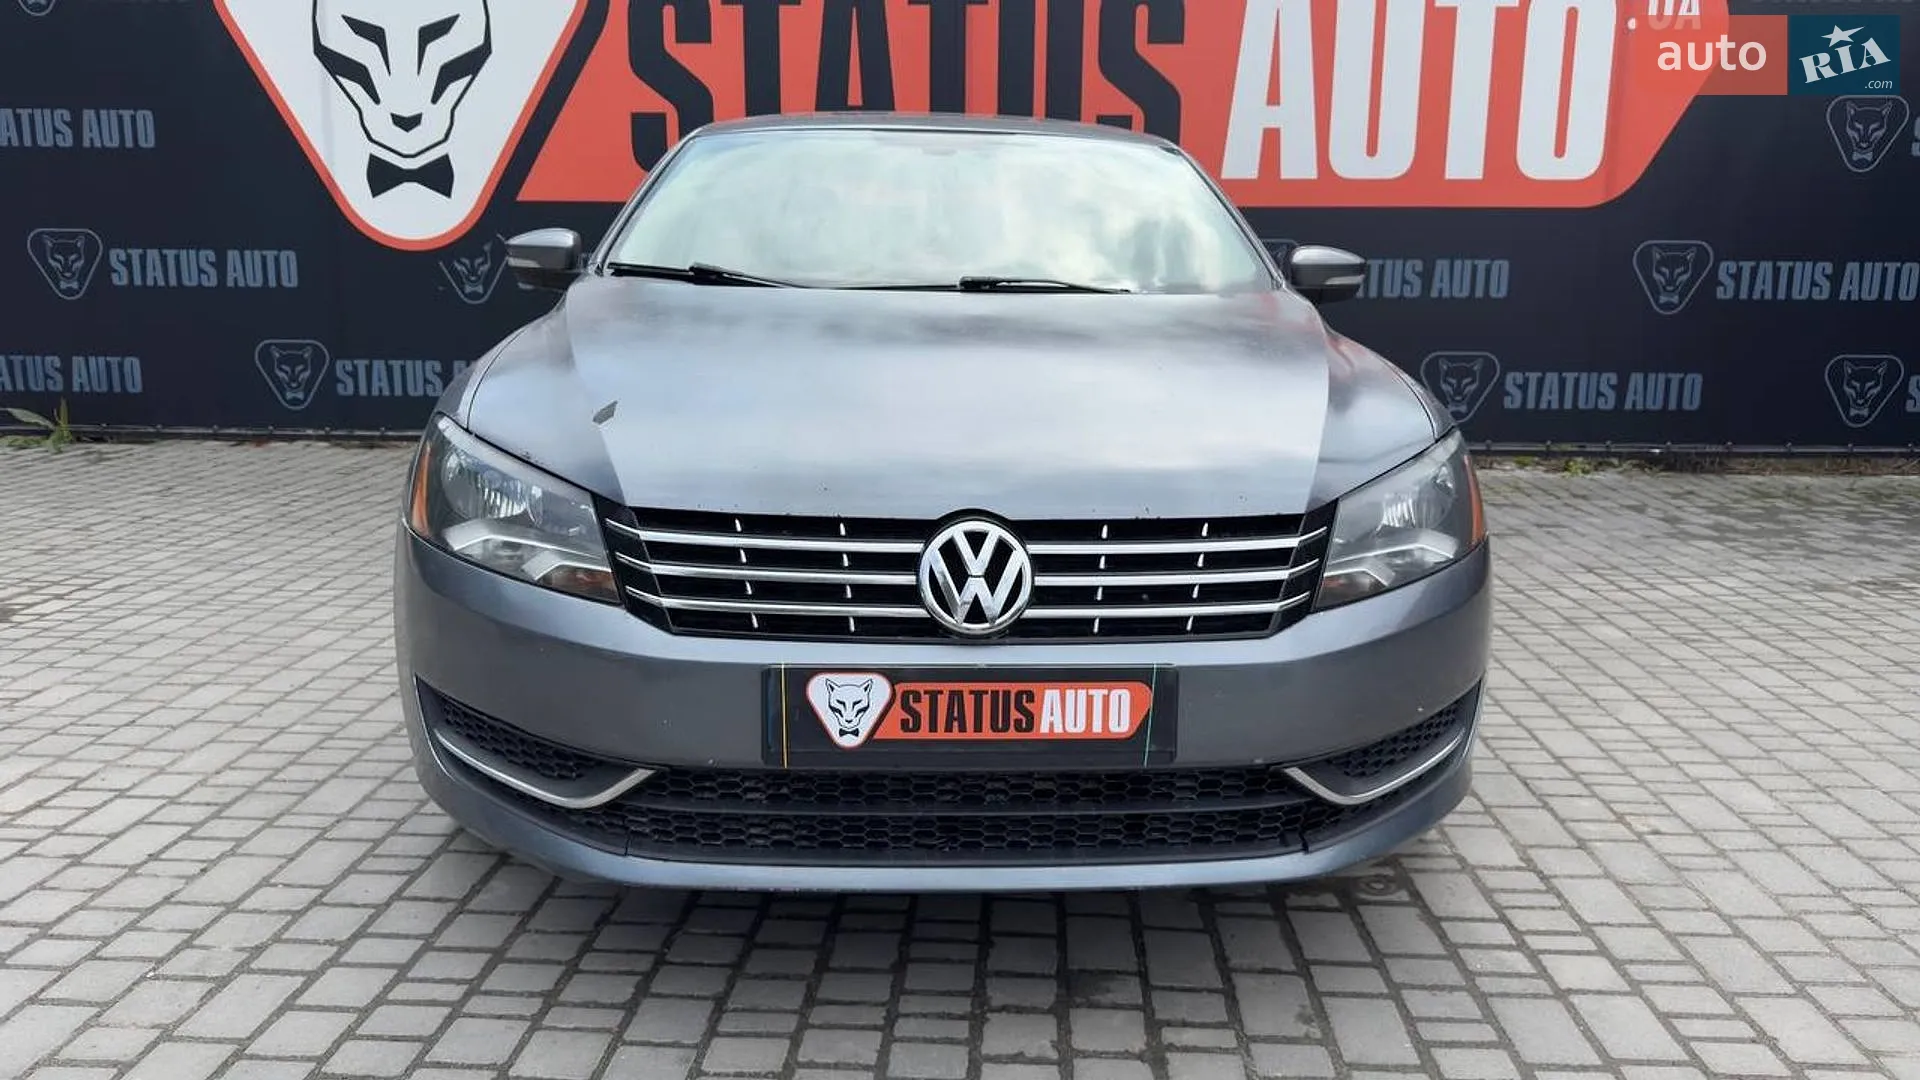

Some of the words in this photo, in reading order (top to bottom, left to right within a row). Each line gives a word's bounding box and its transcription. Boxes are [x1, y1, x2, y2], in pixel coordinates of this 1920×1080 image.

[628, 0, 1186, 173] STATUS
[1221, 0, 1618, 180] AUTO
[82, 109, 155, 148] AUTO
[109, 248, 218, 288] STATUS
[226, 250, 299, 288] AUTO
[1356, 259, 1424, 298] TUS
[1430, 259, 1509, 298] AUTO
[1716, 261, 1833, 300] STATUS
[1839, 262, 1920, 301] AUTO
[72, 355, 143, 393] AUTO
[335, 359, 444, 397] STATUS
[1504, 372, 1618, 410] STATUS
[1624, 372, 1703, 411] AUTO
